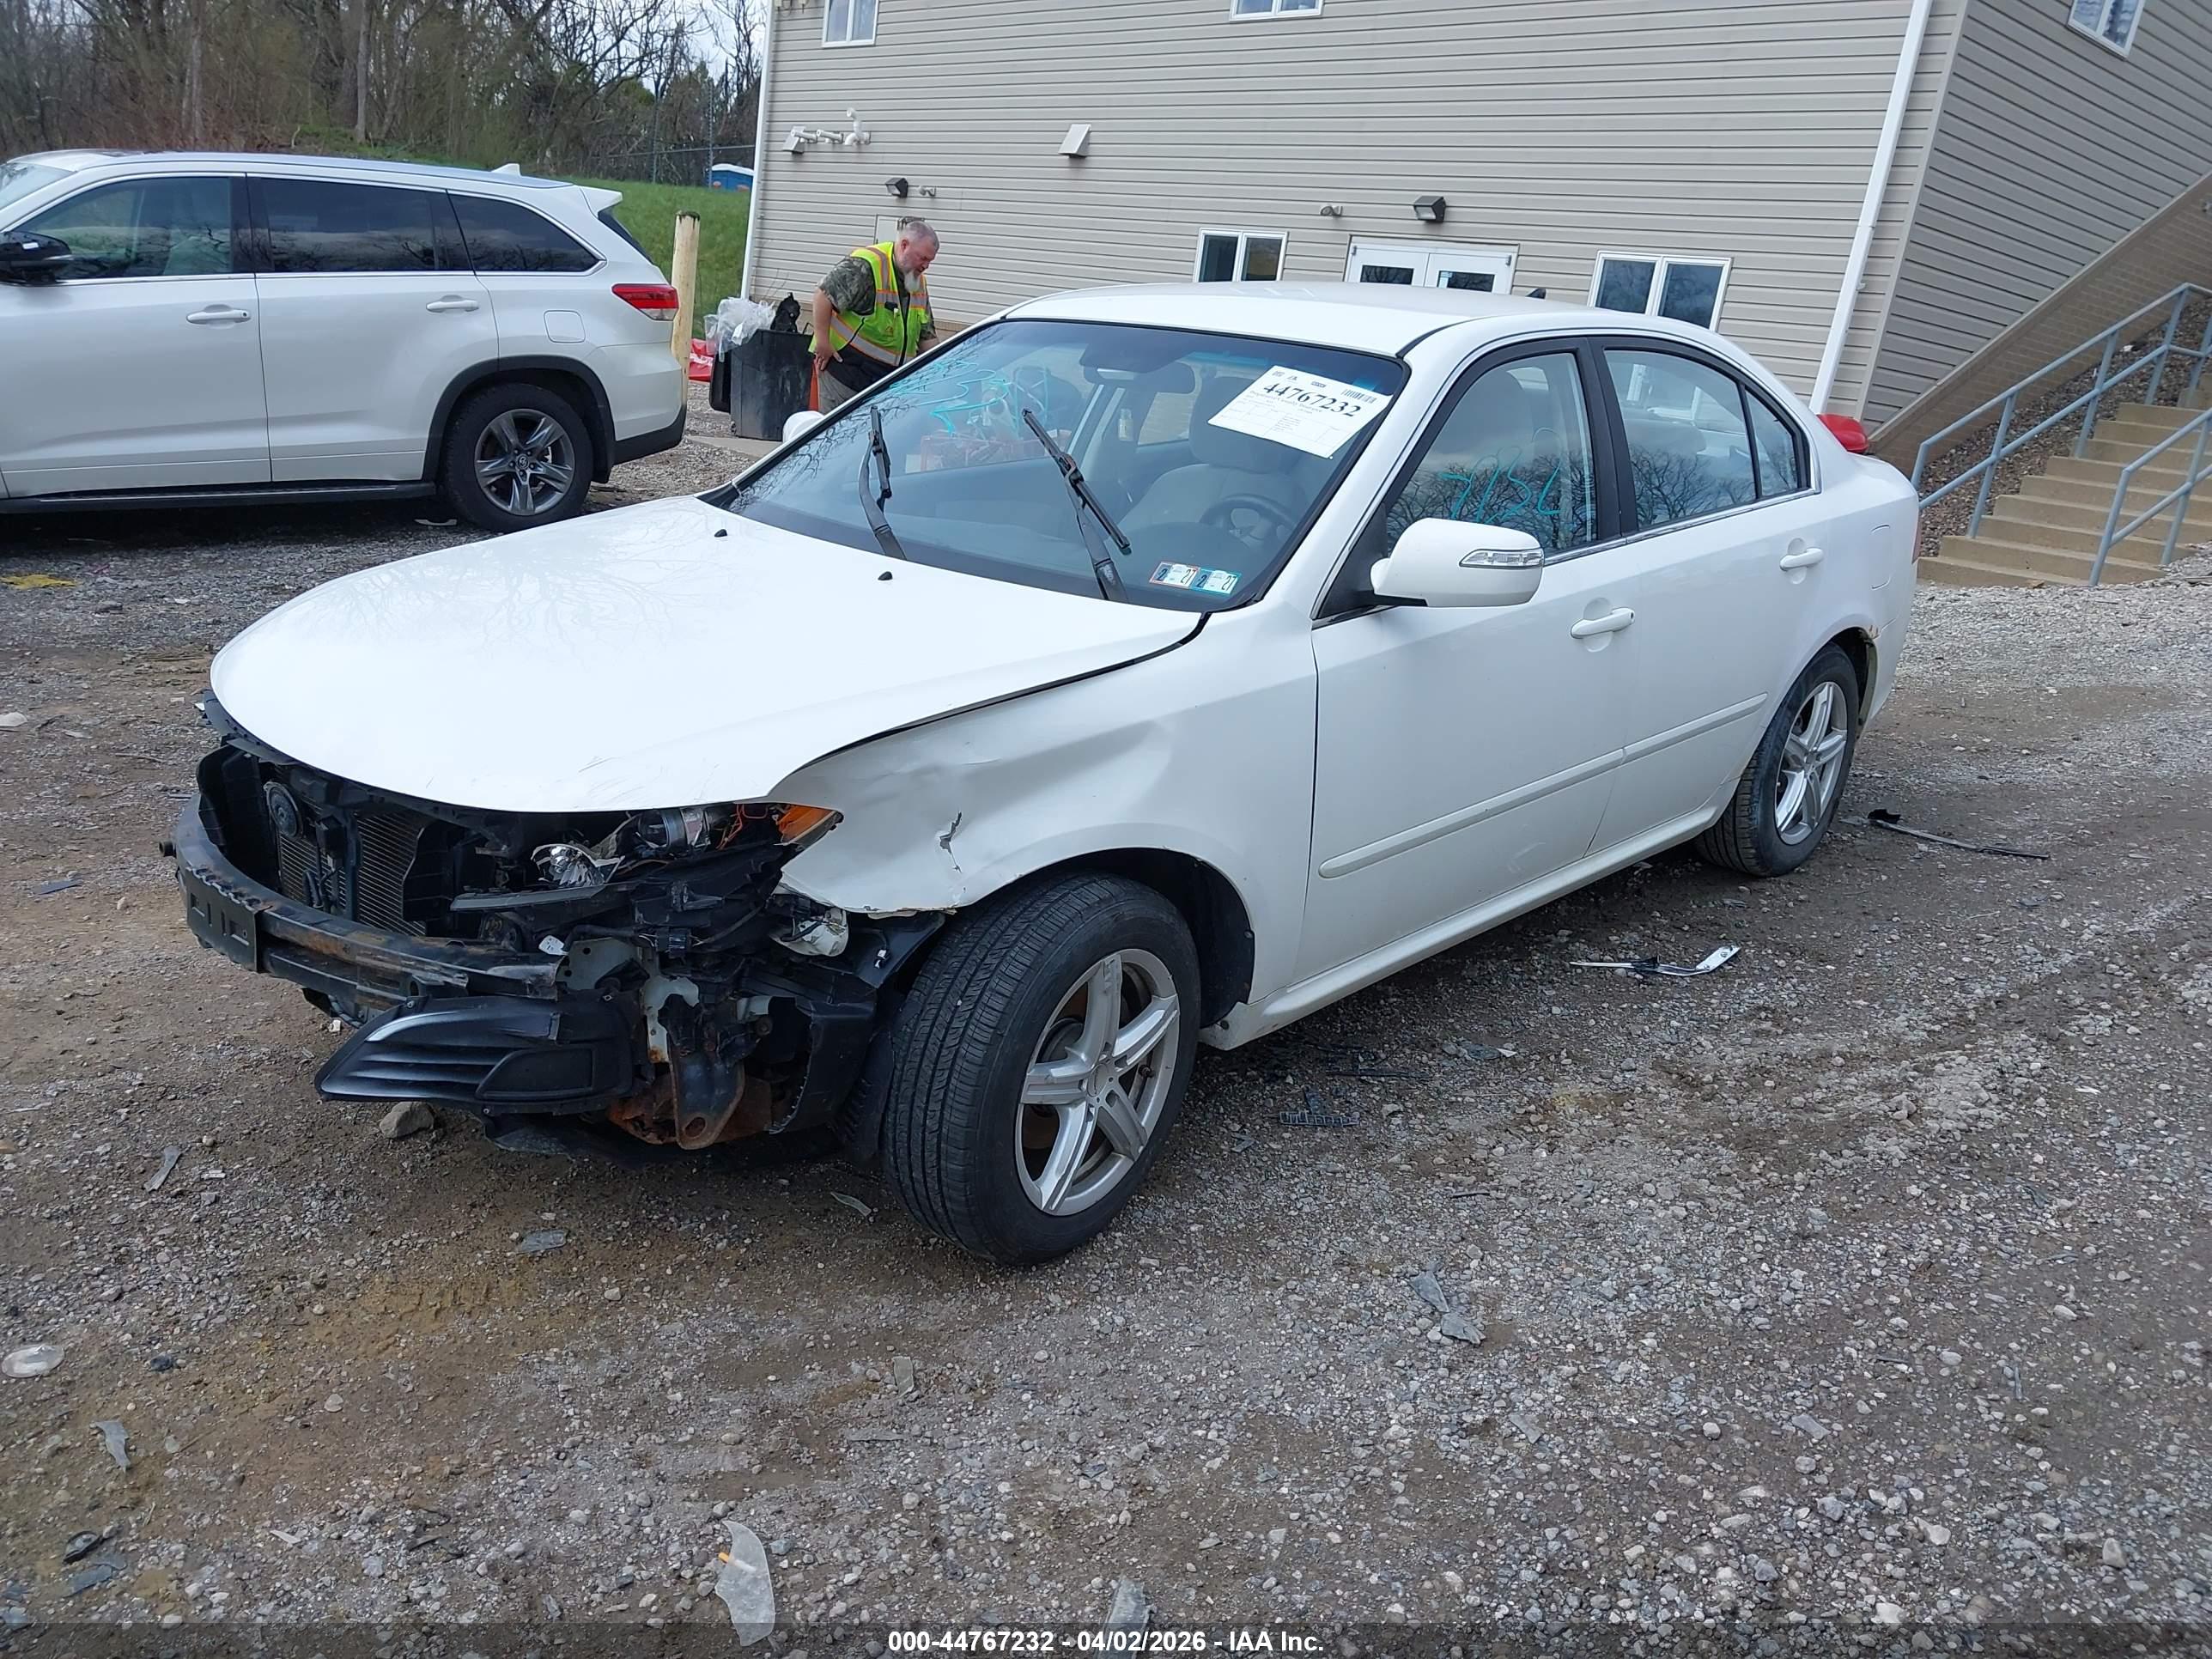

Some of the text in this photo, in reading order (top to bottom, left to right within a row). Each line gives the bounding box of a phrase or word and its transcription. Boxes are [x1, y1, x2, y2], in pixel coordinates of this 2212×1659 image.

[1263, 382, 1363, 417] 44767232
[1180, 568, 1196, 585] 27
[1221, 575, 1237, 591] 27
